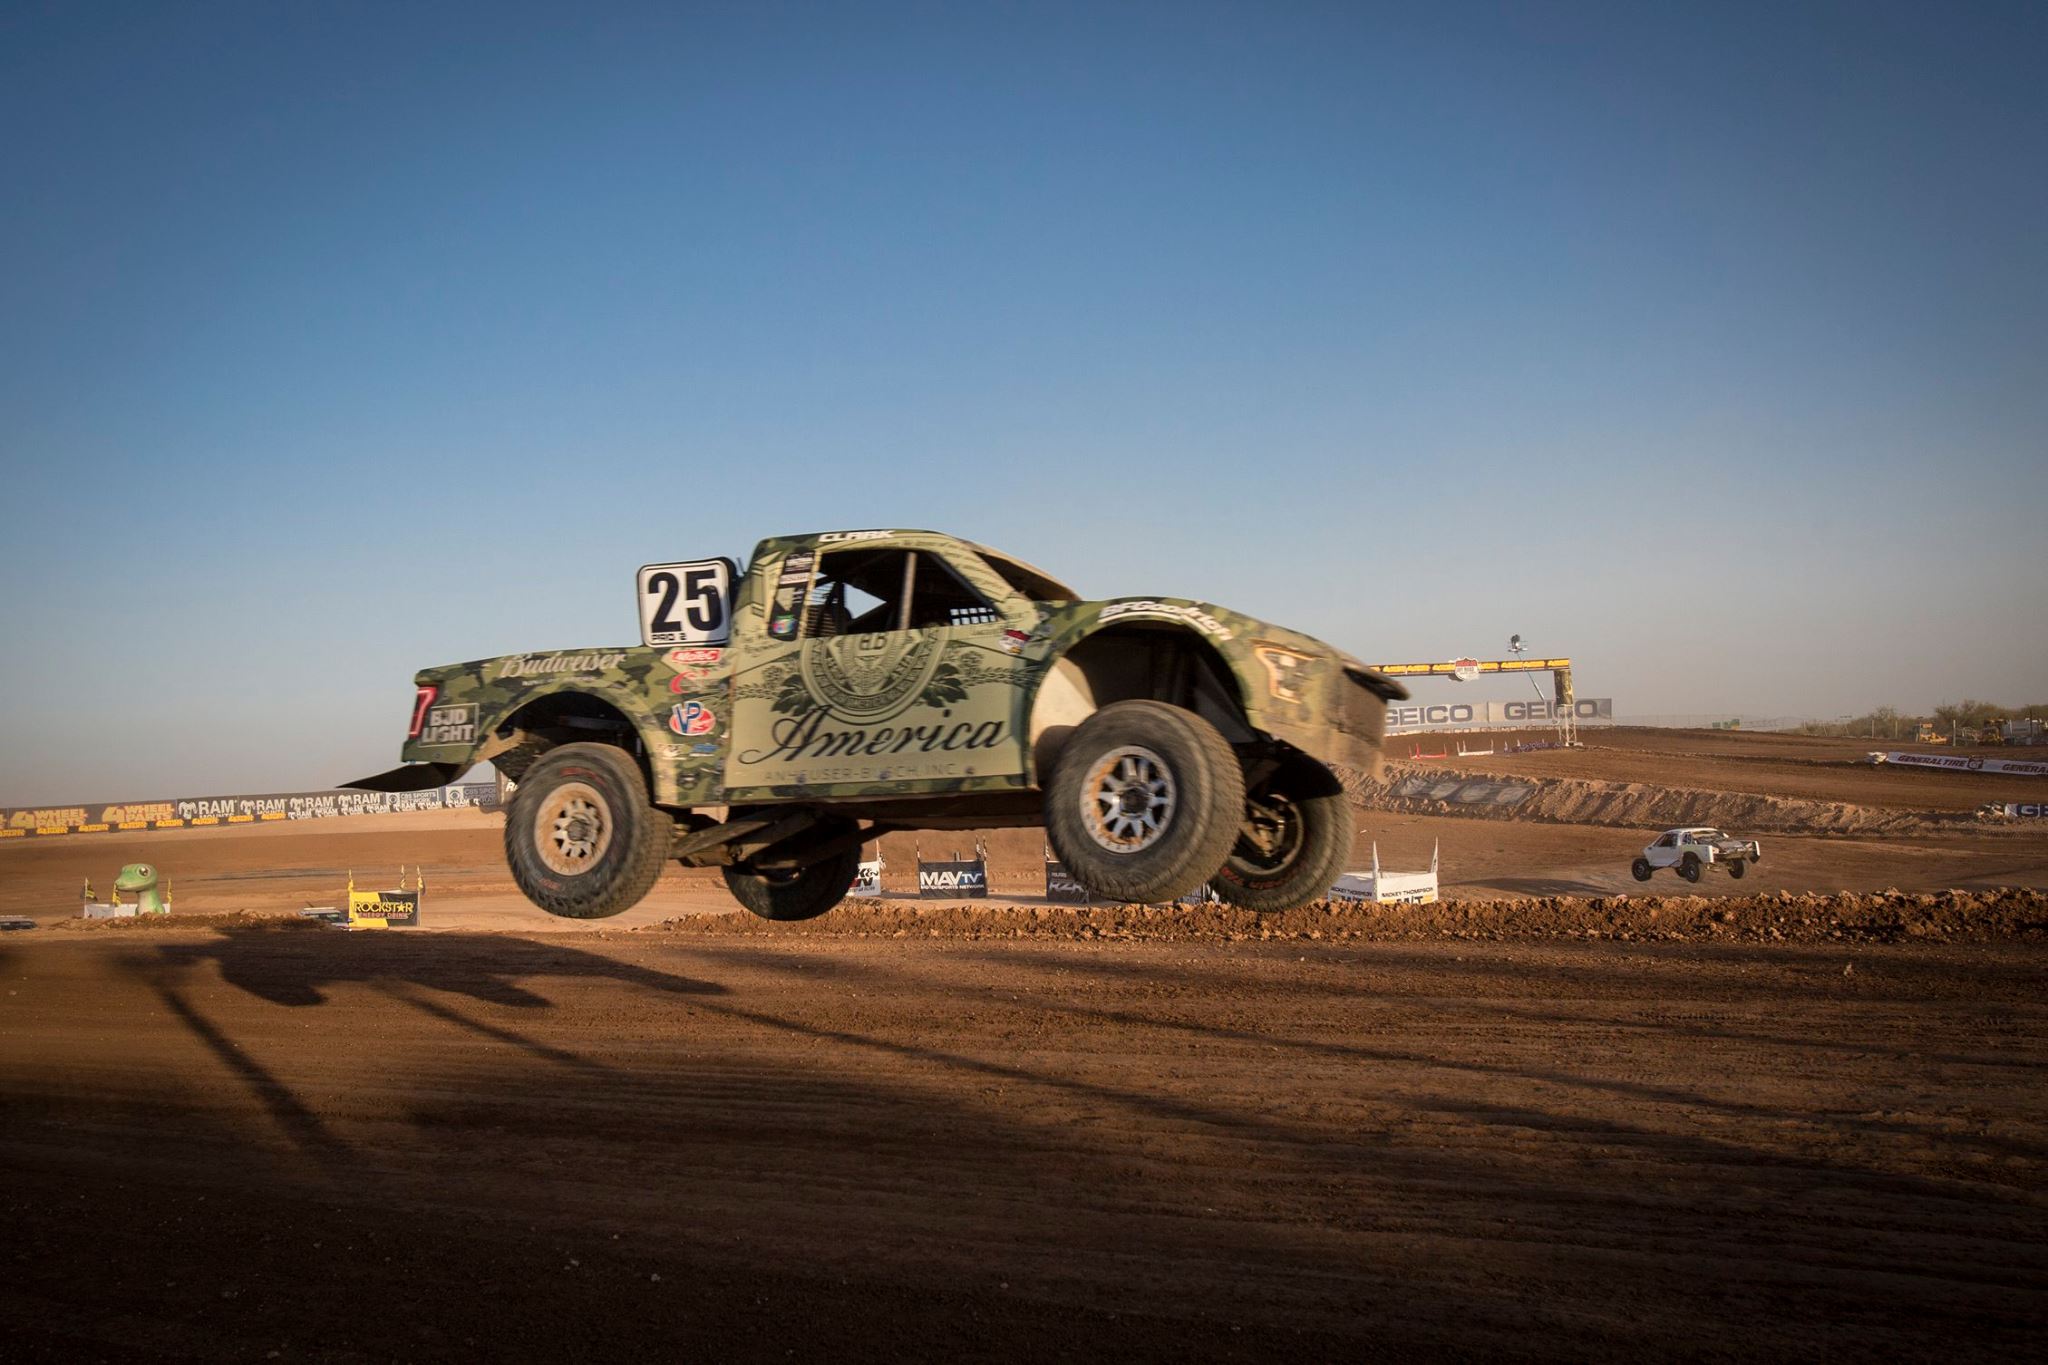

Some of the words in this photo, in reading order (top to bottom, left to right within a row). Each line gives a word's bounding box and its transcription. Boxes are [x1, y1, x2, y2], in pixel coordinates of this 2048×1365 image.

[818, 530, 895, 542] CLARK
[648, 569, 723, 633] 25
[500, 651, 627, 678] Budweiser
[430, 708, 467, 726] BUD
[1385, 704, 1473, 726] GEICO
[1503, 700, 1598, 720] GEICO
[421, 724, 474, 742] LIGHT
[738, 704, 1012, 764] America
[1898, 755, 1942, 766] GENERAL
[1942, 758, 1967, 767] TIRE
[198, 800, 235, 815] RAM
[256, 799, 285, 814] RAM
[305, 796, 334, 808] RAM
[353, 793, 381, 804] RAM
